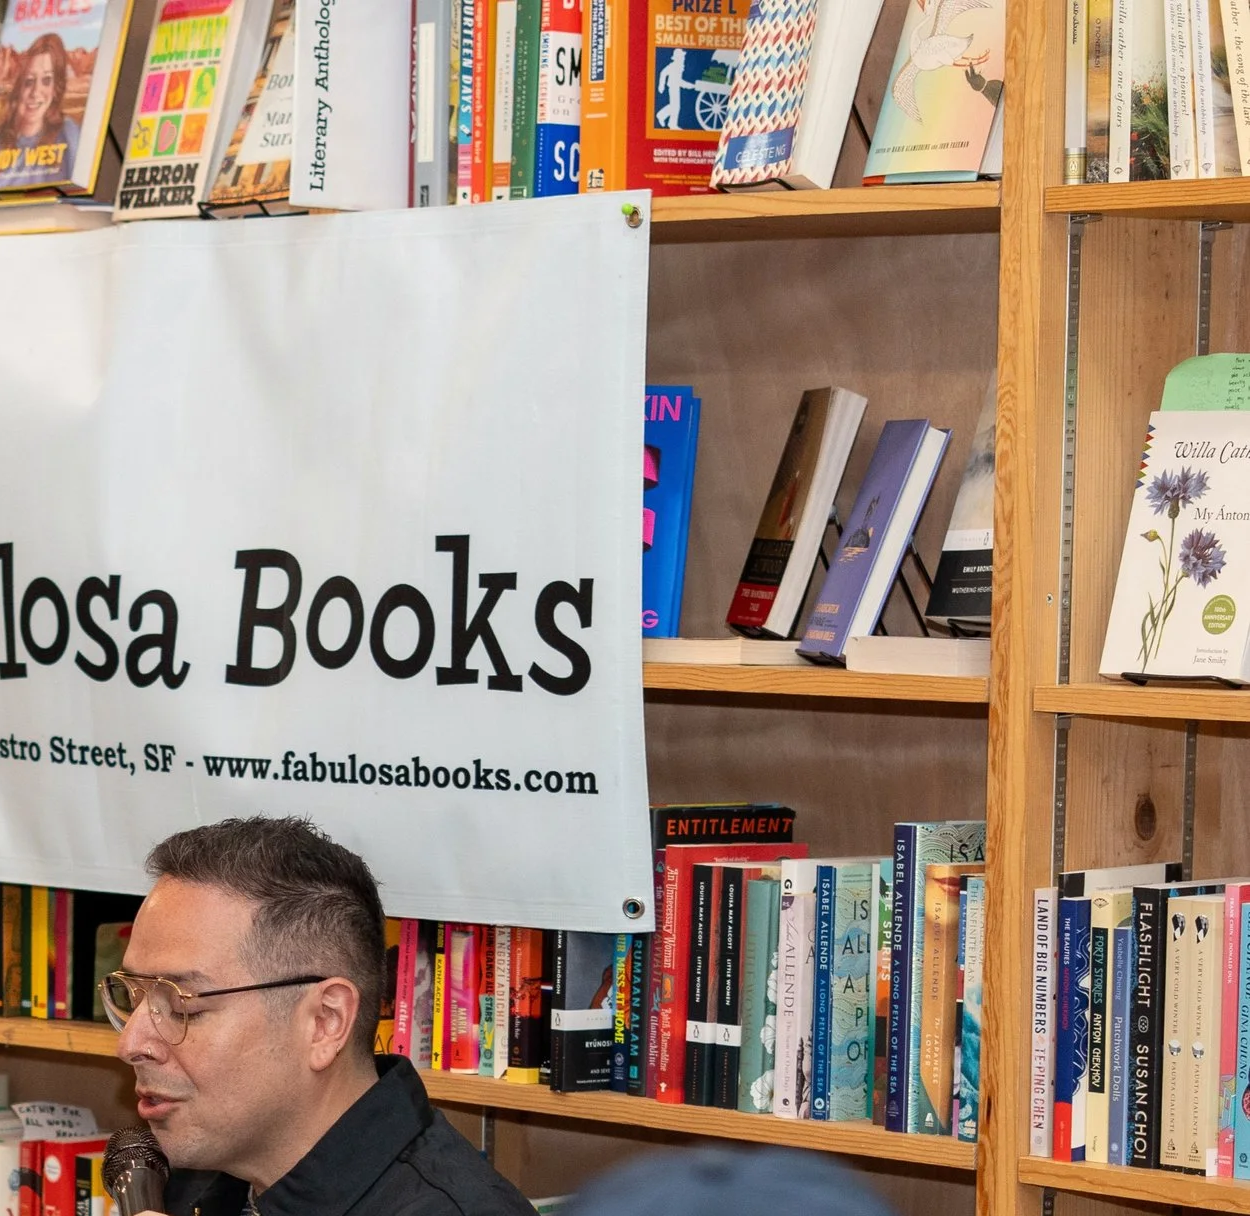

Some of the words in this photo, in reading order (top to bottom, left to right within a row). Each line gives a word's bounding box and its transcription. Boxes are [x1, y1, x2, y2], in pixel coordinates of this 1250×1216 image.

[655, 14, 693, 32] BEST
[695, 16, 718, 32] OF
[1176, 4, 1186, 28] willa
[655, 32, 697, 46] SMALL
[1117, 27, 1128, 65] cather
[1178, 30, 1188, 62] cather
[1235, 53, 1245, 75] song
[461, 74, 473, 113] DAYS
[1179, 74, 1190, 118] pioneers!
[25, 143, 67, 166] WEST
[310, 98, 333, 191] Literary
[735, 147, 775, 163] CELESTE
[775, 145, 786, 157] NG
[123, 163, 199, 188] HARRON
[119, 185, 196, 210] WALKER
[1174, 441, 1216, 458] Willa
[1193, 508, 1213, 525] My
[225, 534, 595, 696] Books
[1203, 613, 1234, 622] ANNIVERSARY
[1208, 622, 1227, 630] EDITION
[1192, 654, 1207, 665] Jane
[1208, 656, 1229, 667] Smiley
[49, 735, 137, 776] Street,
[144, 744, 177, 773] SF
[203, 750, 599, 795] www.fabulosabooks.com
[666, 818, 795, 836] ENTITLEMENT
[666, 866, 678, 881] An
[896, 839, 906, 885] ISABEL
[664, 882, 678, 935] Unnecessary
[821, 878, 830, 917] ISABEL
[893, 891, 904, 952] ALLENDE
[1037, 899, 1049, 931] LAND
[819, 921, 830, 970] ALLENDE
[881, 920, 892, 981] SPIRITS
[1036, 935, 1048, 951] OF
[1063, 932, 1071, 965] BEAUTIES
[1092, 935, 1104, 964] FORTY
[1137, 901, 1153, 1008] FLASHLIGHT
[616, 956, 626, 990] MESS
[632, 939, 643, 1008] RUMAAN
[967, 954, 977, 983] PLAN
[1036, 952, 1047, 972] BIG
[784, 942, 795, 1017] ALLENDE
[892, 968, 900, 1001] LONG
[1091, 967, 1103, 1005] STORIES
[819, 988, 827, 1014] LONG
[1034, 975, 1048, 1034] NUMBERS
[615, 1013, 625, 1044] HOME
[818, 1016, 826, 1041] PETAL
[891, 1004, 899, 1034] PETAL
[1092, 1012, 1102, 1043] ANTON
[630, 1016, 640, 1057] ALAM
[660, 1028, 671, 1072] Alameddine
[818, 1043, 825, 1057] OF
[891, 1037, 898, 1052] OF
[1113, 1016, 1124, 1071] Patchwork
[890, 1054, 898, 1072] THE
[932, 1034, 942, 1085] JAPANESE
[1033, 1048, 1046, 1095] TE-PING
[1090, 1047, 1102, 1088] CHEKHOV
[1135, 1044, 1149, 1105] SUSAN
[889, 1076, 897, 1094] SEA
[1112, 1075, 1122, 1103] Dolls
[1033, 1096, 1045, 1130] CHEN
[1133, 1110, 1148, 1160] CHOI
